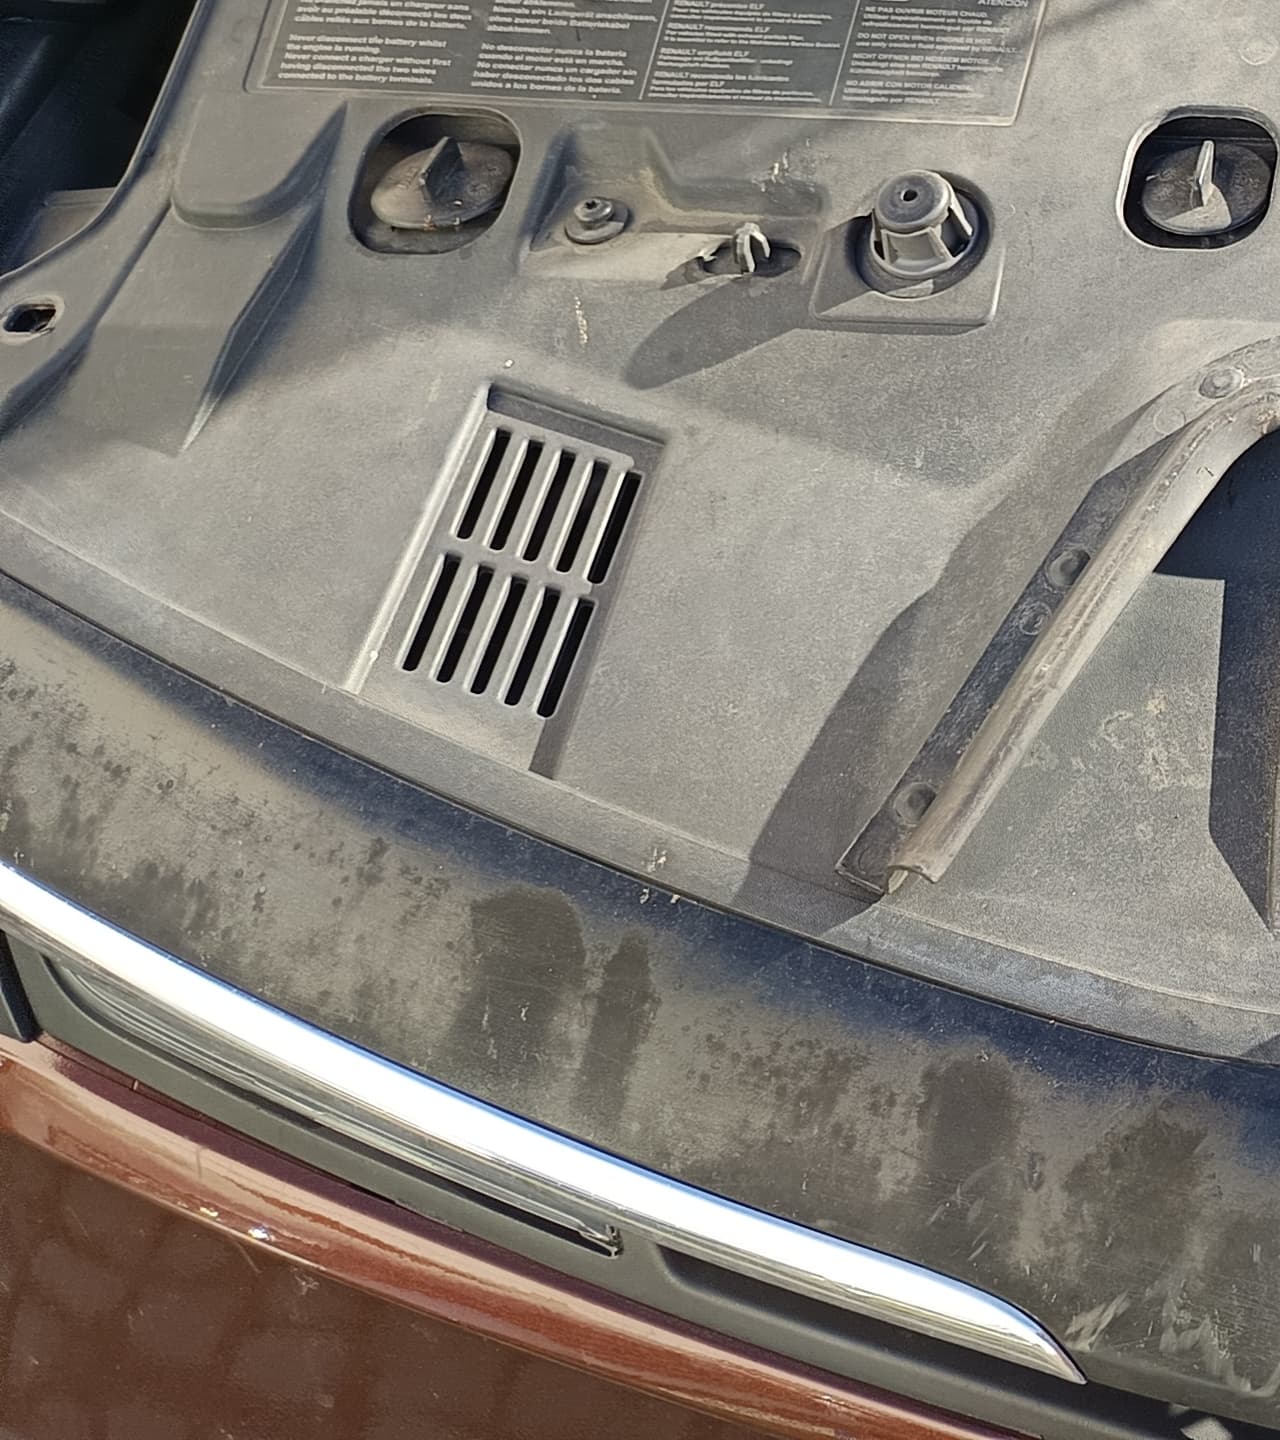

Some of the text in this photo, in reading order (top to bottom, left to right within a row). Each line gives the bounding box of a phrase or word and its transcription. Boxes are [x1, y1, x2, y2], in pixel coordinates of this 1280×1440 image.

[286, 42, 301, 50] the
[302, 43, 333, 51] engine
[289, 32, 446, 48] Never disconnect the battery whilst
[284, 50, 311, 59] Never
[312, 52, 350, 61] connect
[358, 54, 394, 64] charger
[395, 56, 431, 65] without
[431, 58, 451, 67] first
[278, 69, 326, 79] connected
[338, 72, 354, 81] the
[355, 73, 388, 83] battery
[281, 60, 437, 76] having disconnected the two wires
